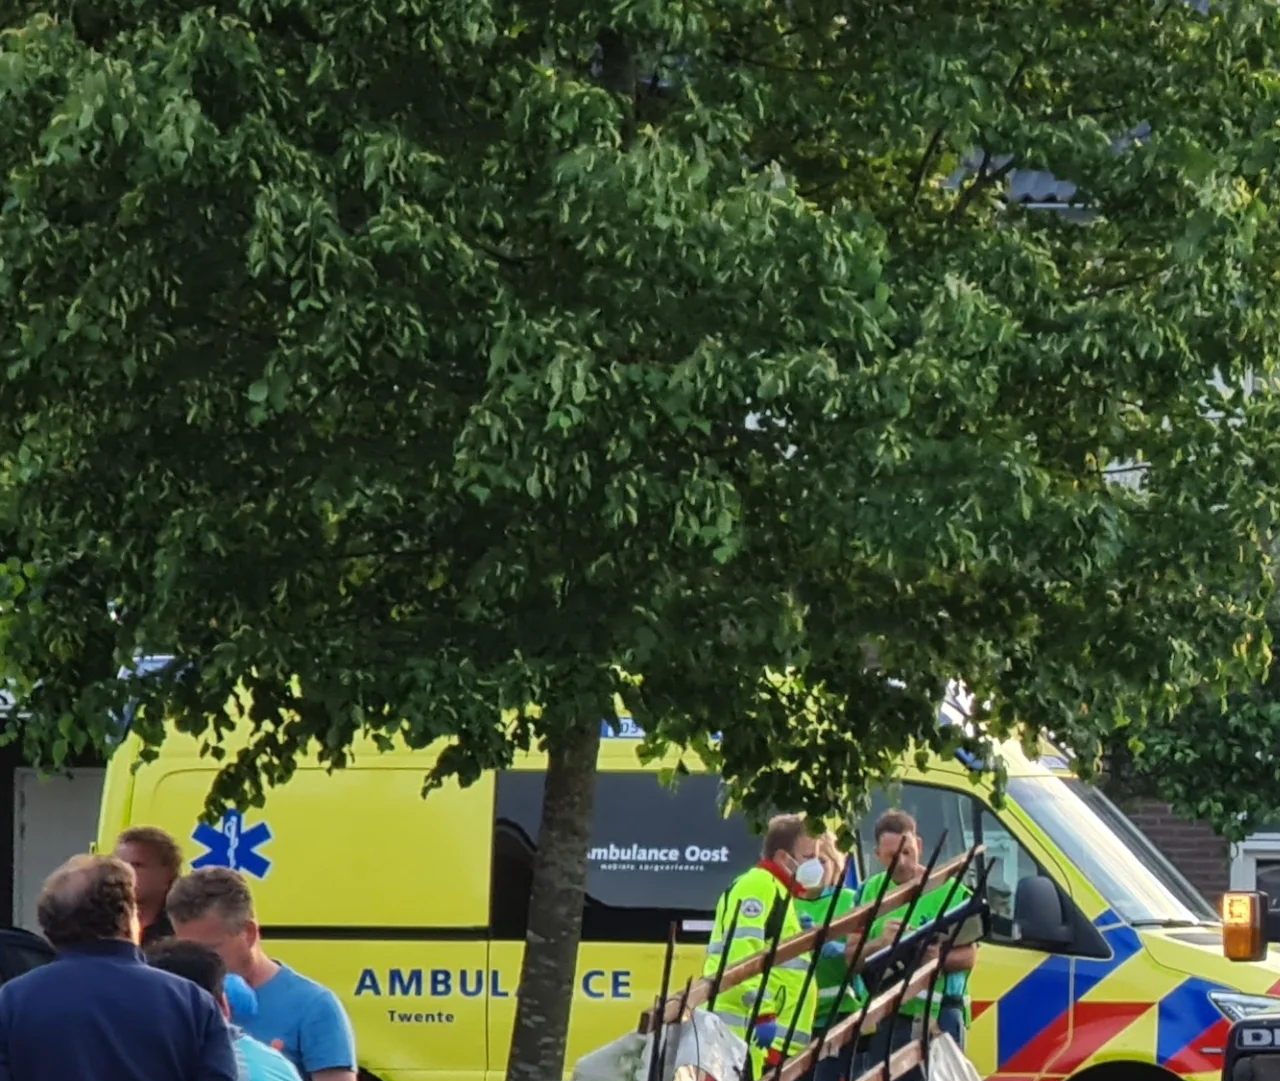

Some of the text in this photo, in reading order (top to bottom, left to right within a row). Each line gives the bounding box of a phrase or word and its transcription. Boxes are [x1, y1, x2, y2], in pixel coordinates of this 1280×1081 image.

[587, 843, 729, 862] mbulance Oost
[354, 968, 631, 998] AMBULCE
[388, 1010, 455, 1023] Twente
